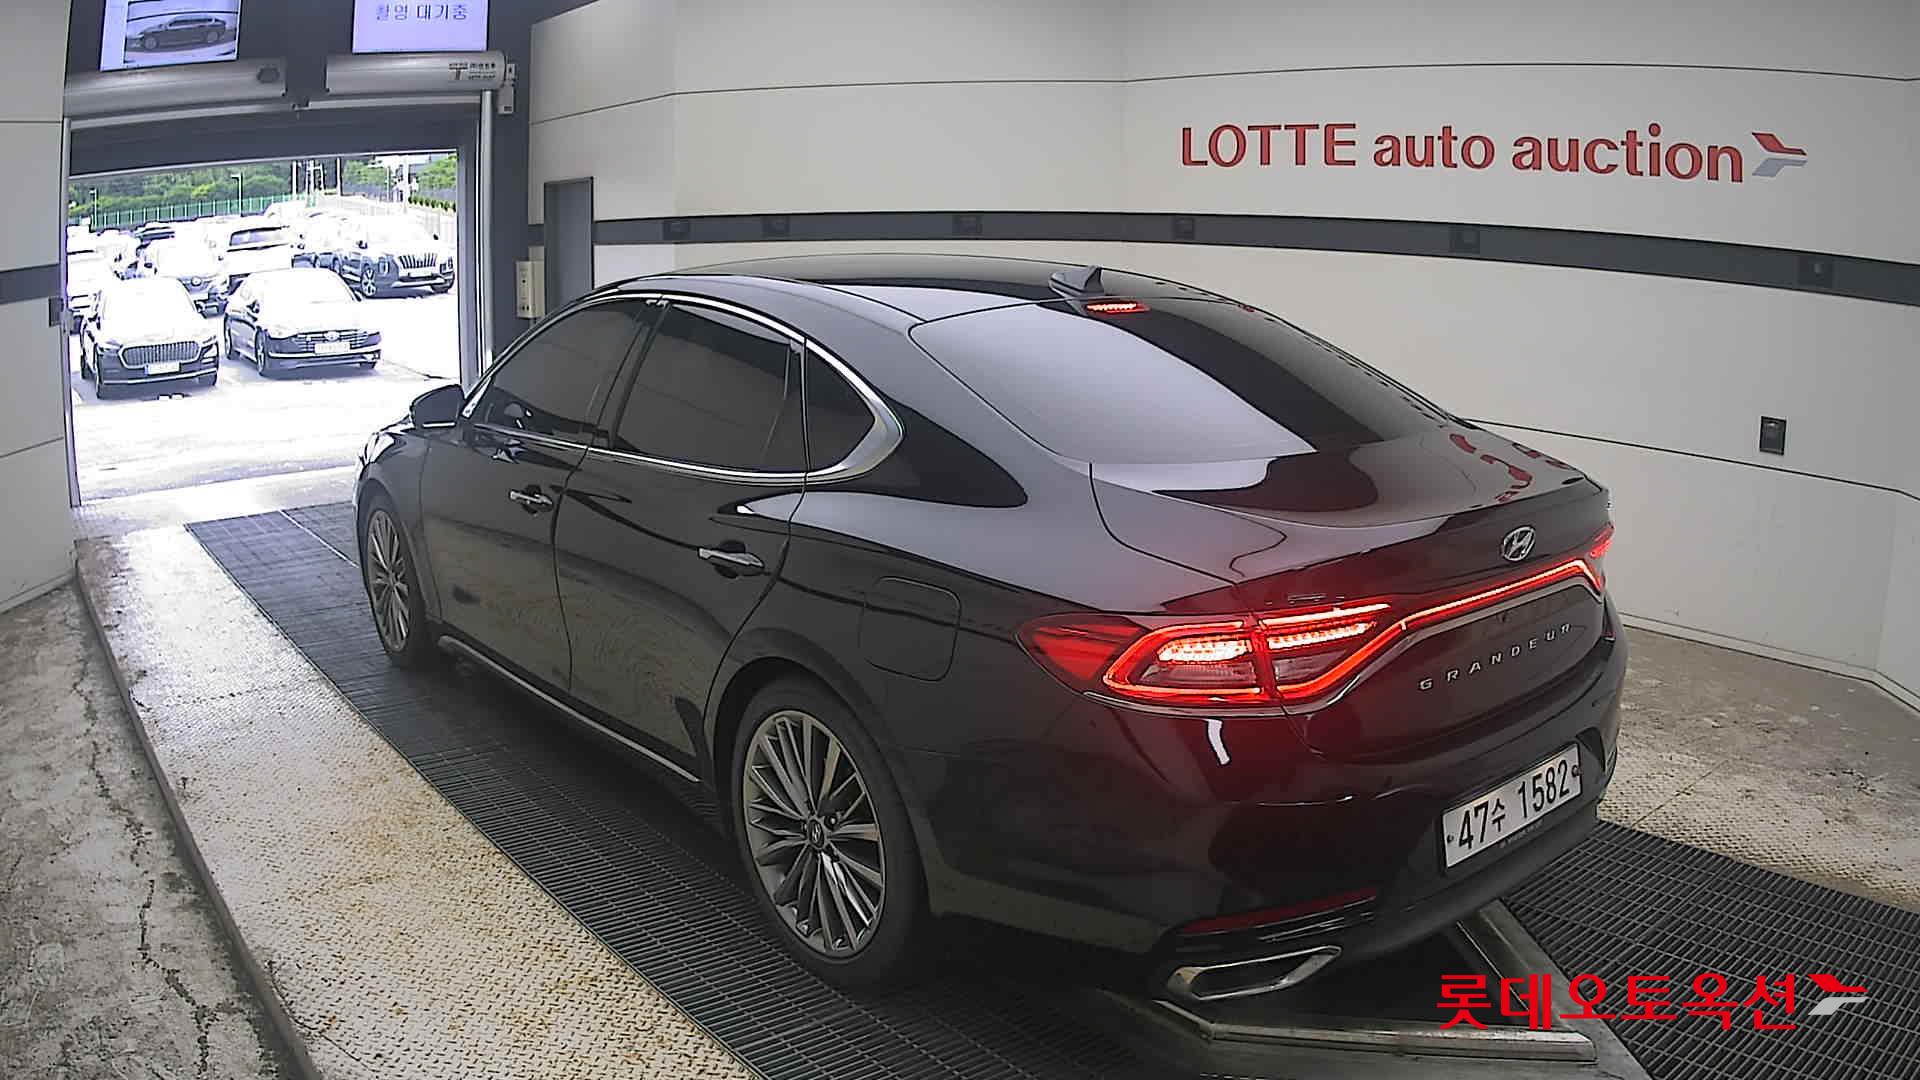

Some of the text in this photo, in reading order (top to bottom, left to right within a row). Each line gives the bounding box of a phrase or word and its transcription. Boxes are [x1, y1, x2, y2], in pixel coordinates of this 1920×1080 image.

[1181, 122, 1745, 183] LOTTE auto auction
[1419, 622, 1572, 691] GRANDEUR
[1458, 798, 1506, 850] 47수
[1517, 759, 1571, 819] 1582
